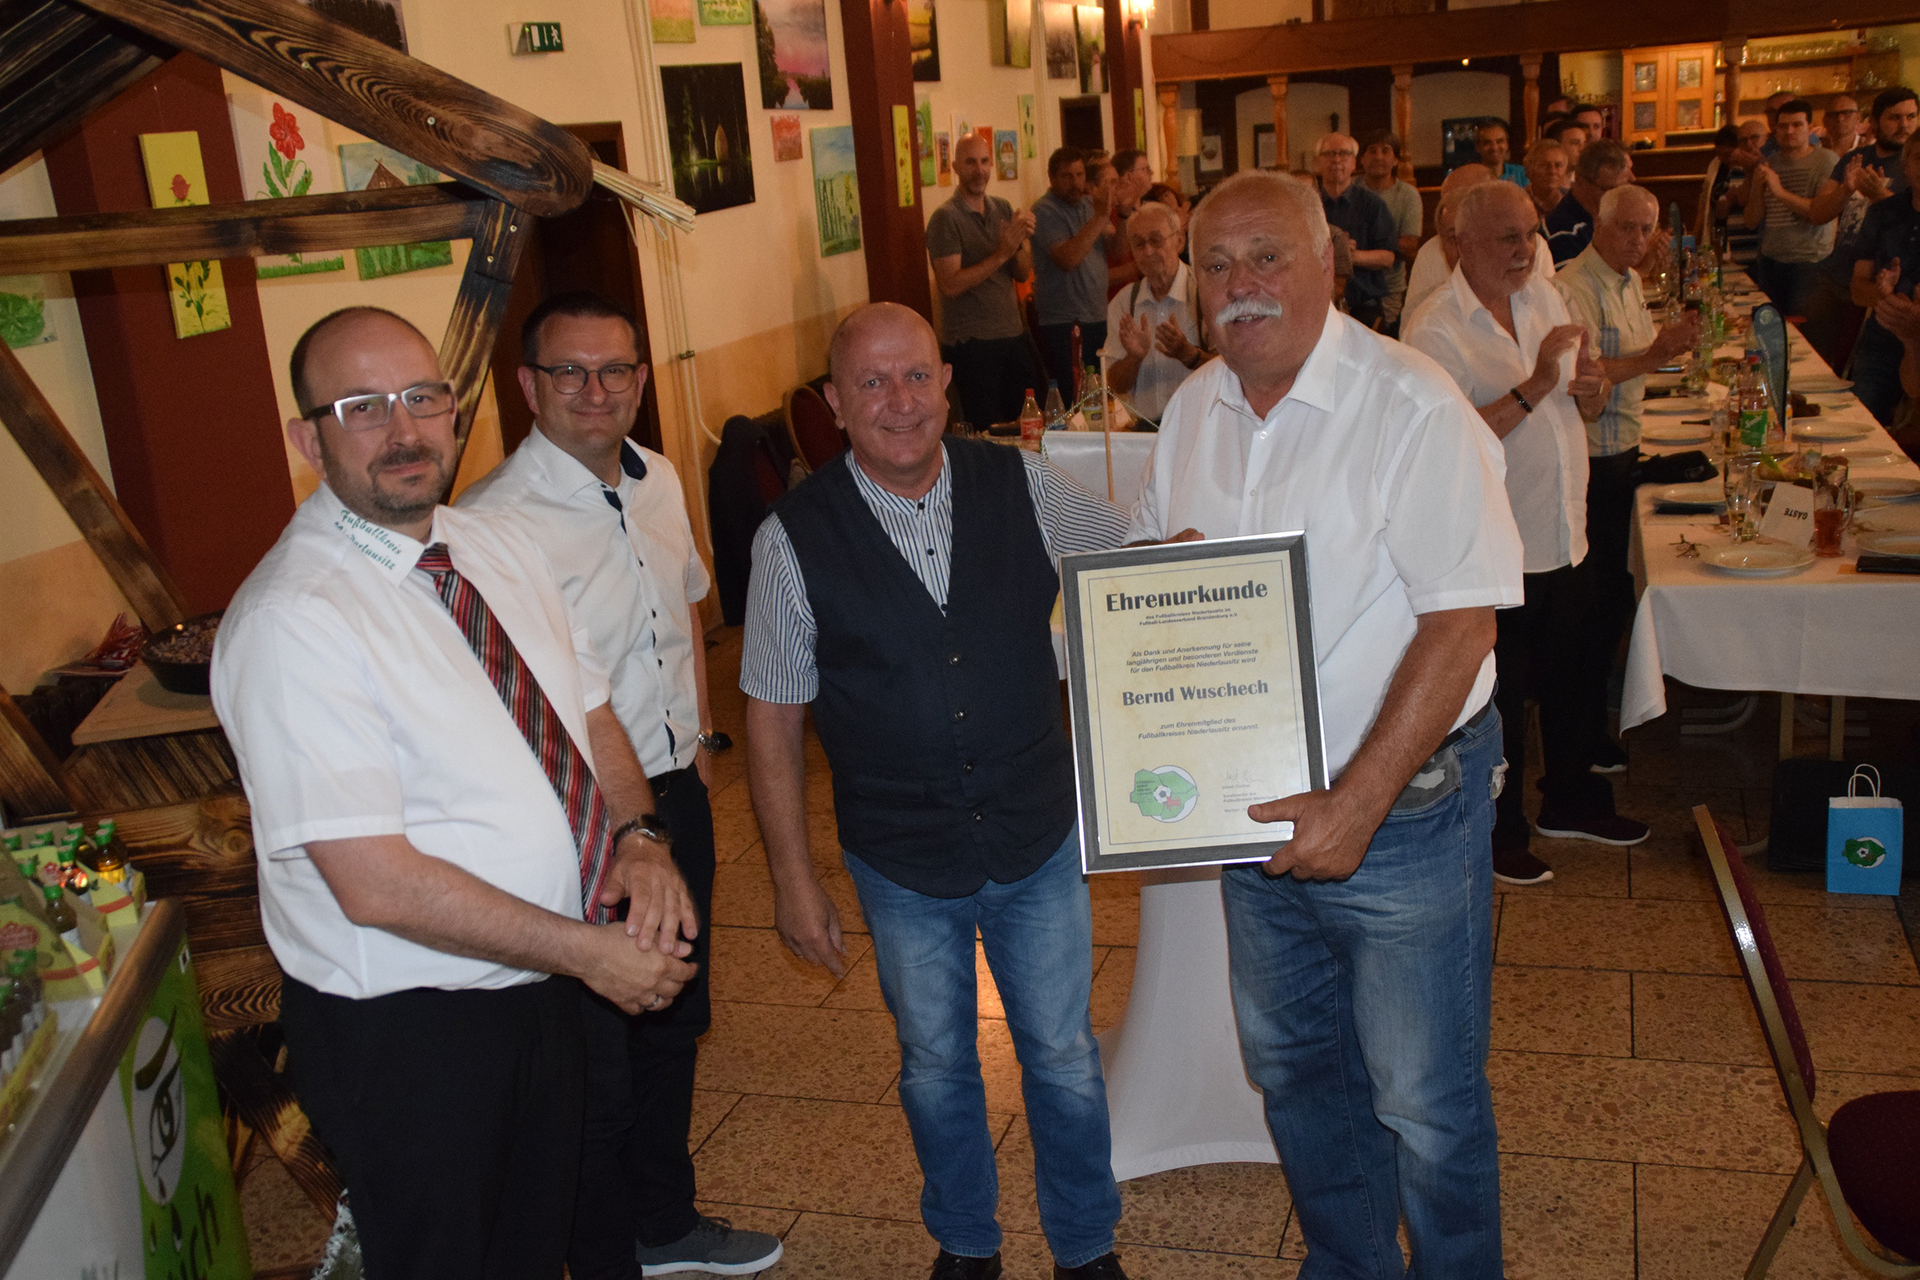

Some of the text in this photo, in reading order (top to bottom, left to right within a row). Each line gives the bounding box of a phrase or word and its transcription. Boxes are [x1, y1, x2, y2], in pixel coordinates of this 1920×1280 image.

[340, 509, 402, 555] Fußballkreis
[334, 521, 396, 570] derlausitz
[1106, 580, 1268, 612] Ehrenurkunde
[1126, 657, 1167, 667] langjährigen
[1182, 652, 1222, 661] besonderen
[1223, 648, 1259, 657] Verdienste
[1143, 649, 1161, 657] Dank
[1176, 643, 1221, 654] Anerkennung
[1155, 662, 1195, 672] Fußballkreis
[1196, 658, 1240, 668] Niederlausitz
[1241, 656, 1256, 664] wird
[1122, 679, 1269, 706] Bernd Wuschech
[1138, 723, 1260, 740] Fußballkreises Niederlausitz ernannt.
[1176, 718, 1223, 729] Ehrenmitglied
